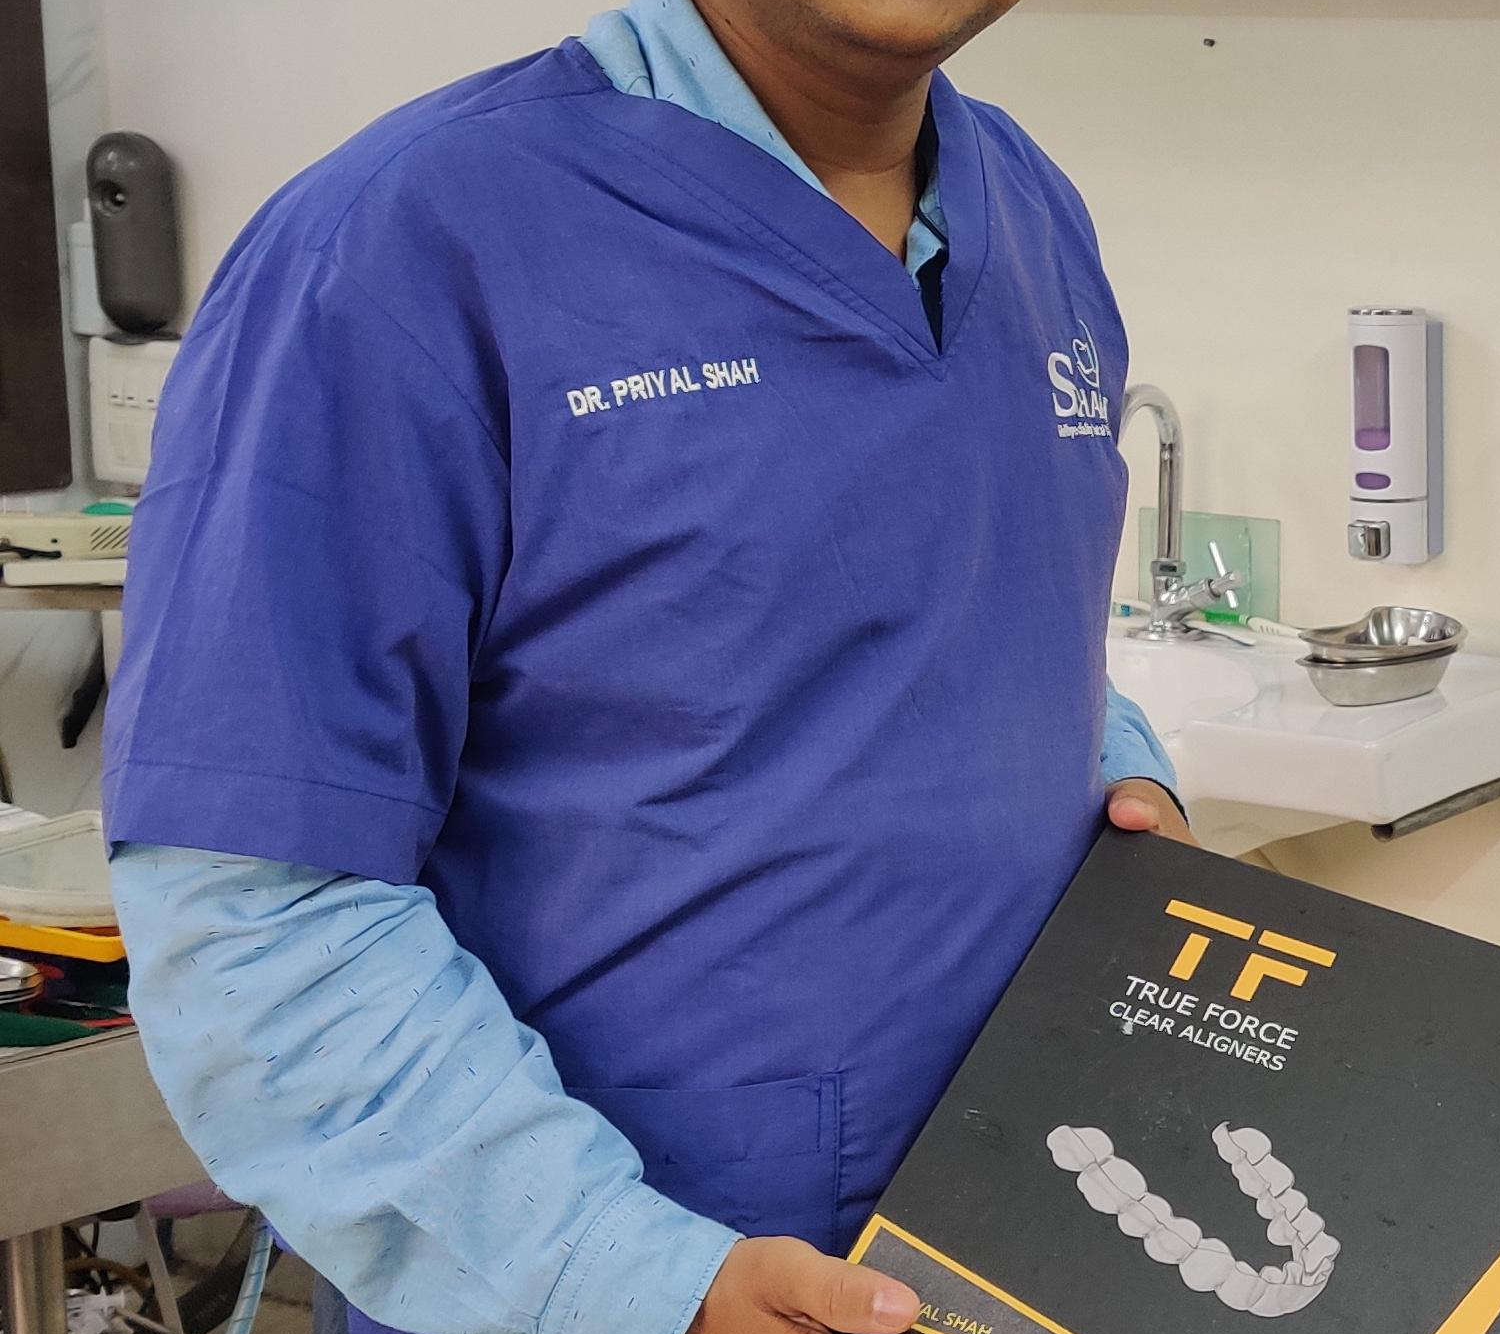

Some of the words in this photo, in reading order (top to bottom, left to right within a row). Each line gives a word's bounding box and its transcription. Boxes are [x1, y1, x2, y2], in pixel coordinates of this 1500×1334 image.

[566, 385, 611, 417] DR.
[610, 366, 701, 407] PRIYAL
[702, 358, 761, 389] SHAH
[1164, 898, 1338, 1002] TF
[1108, 1001, 1176, 1036] CLEAR
[1177, 1024, 1287, 1071] ALIGNERS
[1125, 974, 1200, 1017] TRUE
[1202, 1002, 1299, 1050] FORCE
